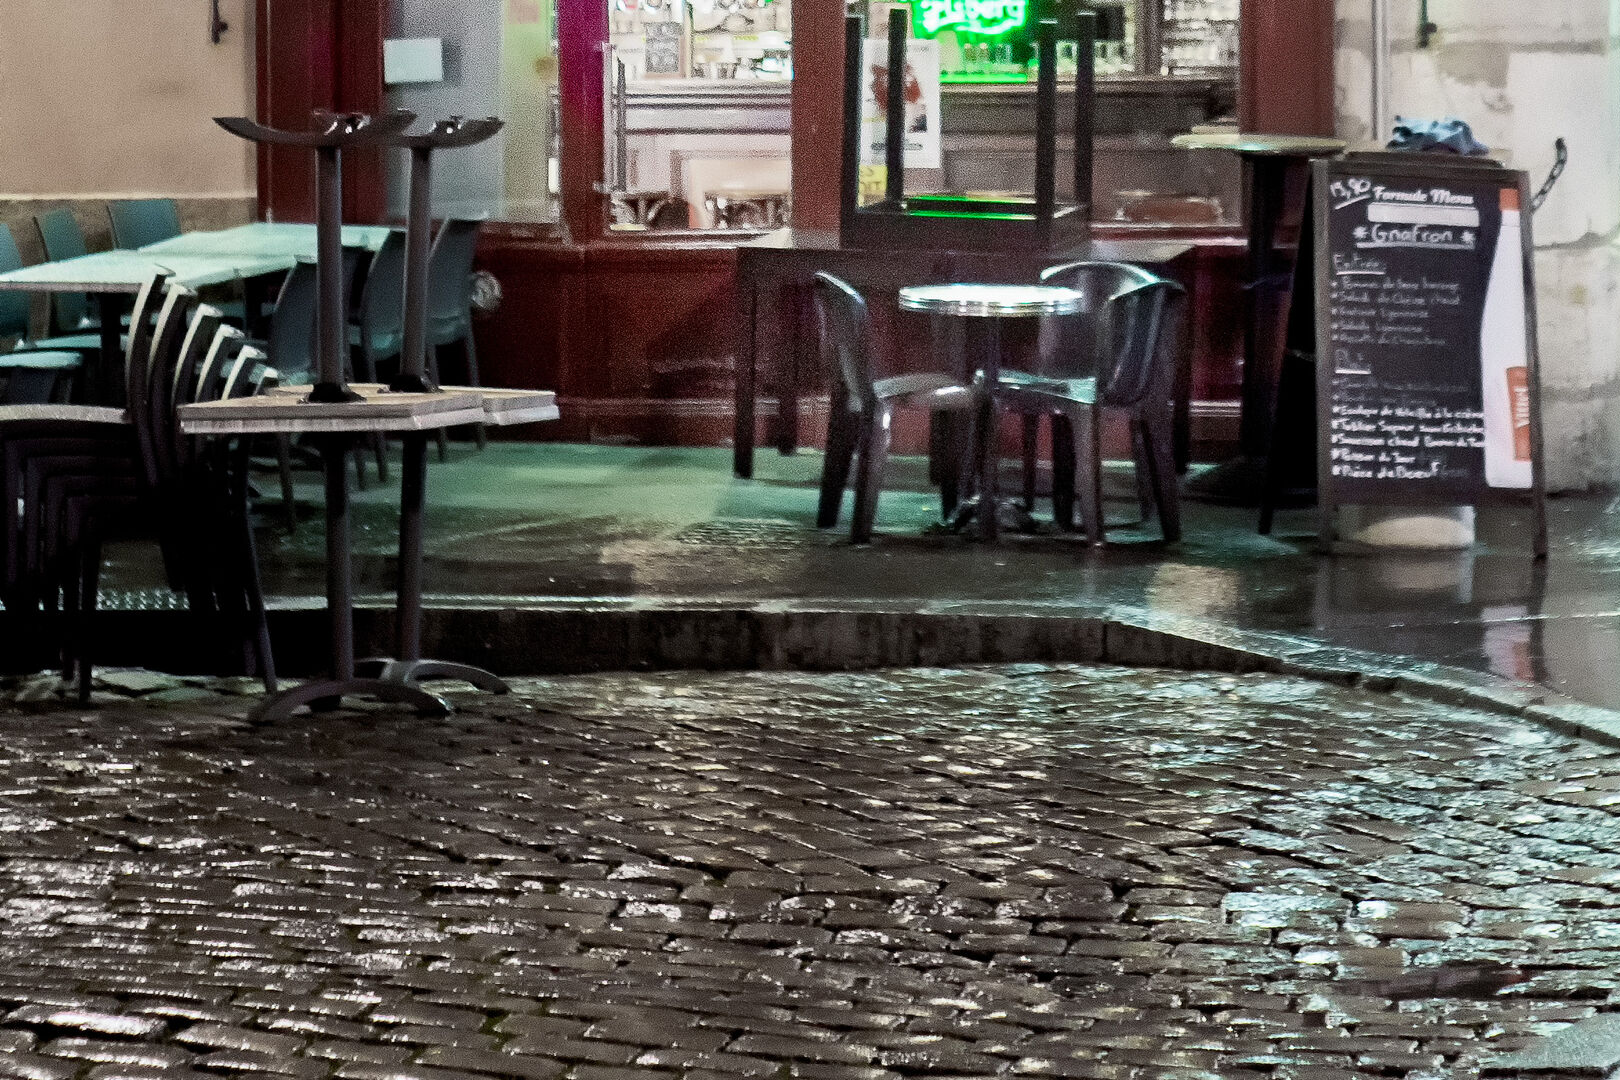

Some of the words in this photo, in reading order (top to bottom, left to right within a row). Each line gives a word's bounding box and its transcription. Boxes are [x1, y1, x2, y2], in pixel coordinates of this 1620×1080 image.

[1373, 186, 1427, 202] Formule
[1429, 188, 1475, 205] Menu
[1371, 223, 1453, 244] Gnafron
